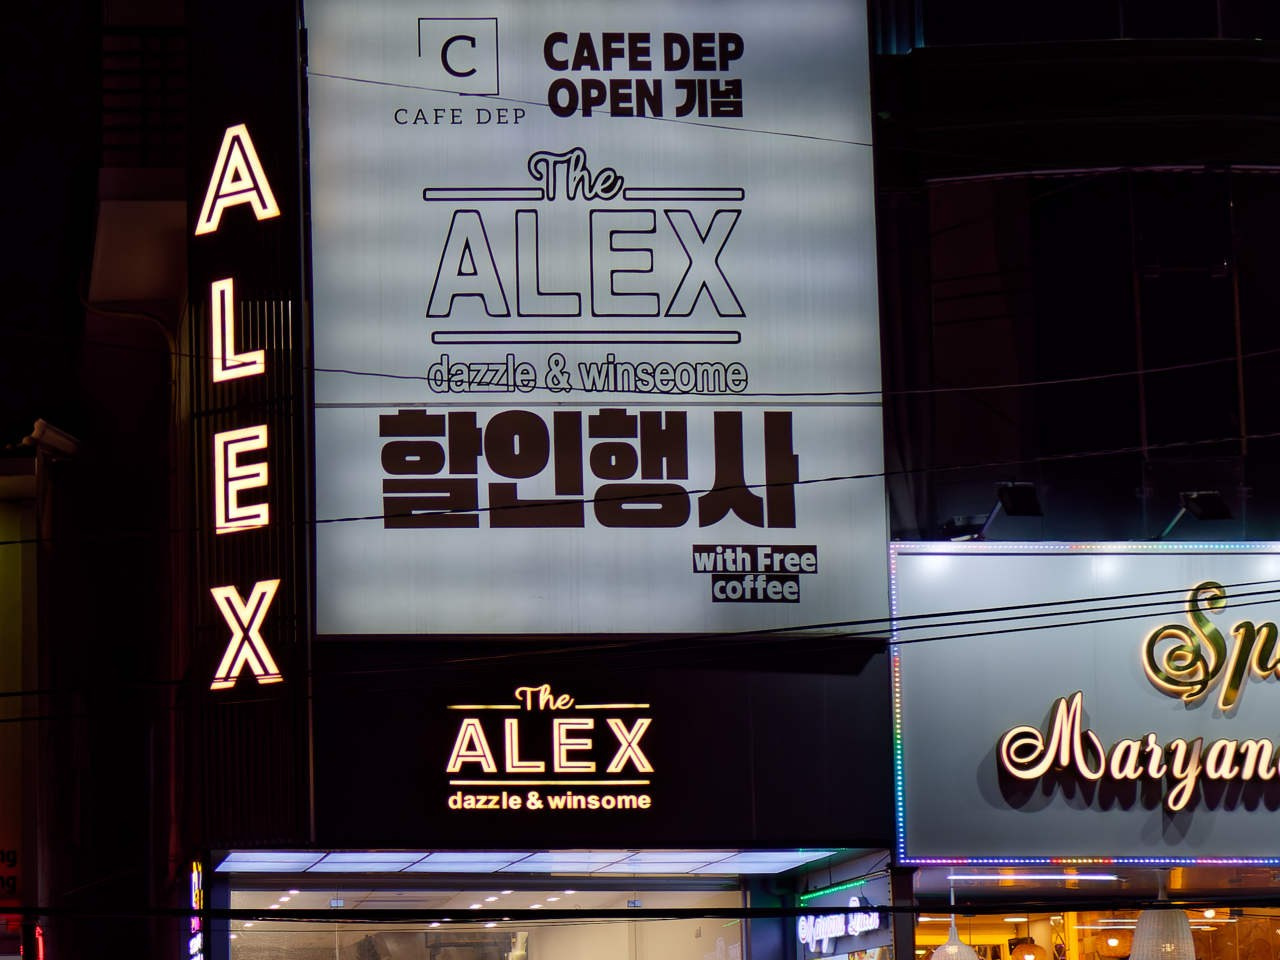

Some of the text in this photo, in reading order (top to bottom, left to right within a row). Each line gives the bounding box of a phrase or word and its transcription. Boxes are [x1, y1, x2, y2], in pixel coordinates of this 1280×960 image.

[543, 31, 745, 72] CAFE DEP
[394, 108, 526, 126] CAFE DEP
[547, 78, 744, 118] OPEN 기념
[527, 147, 624, 201] The
[426, 208, 746, 319] ALEX
[427, 353, 748, 393] dazzle & winseome
[378, 408, 800, 529] 할인행사
[694, 546, 817, 573] with Free
[713, 575, 799, 601] coffee
[515, 684, 575, 711] The
[446, 717, 655, 774] ALEX
[448, 791, 652, 810] dazzle & winsome
